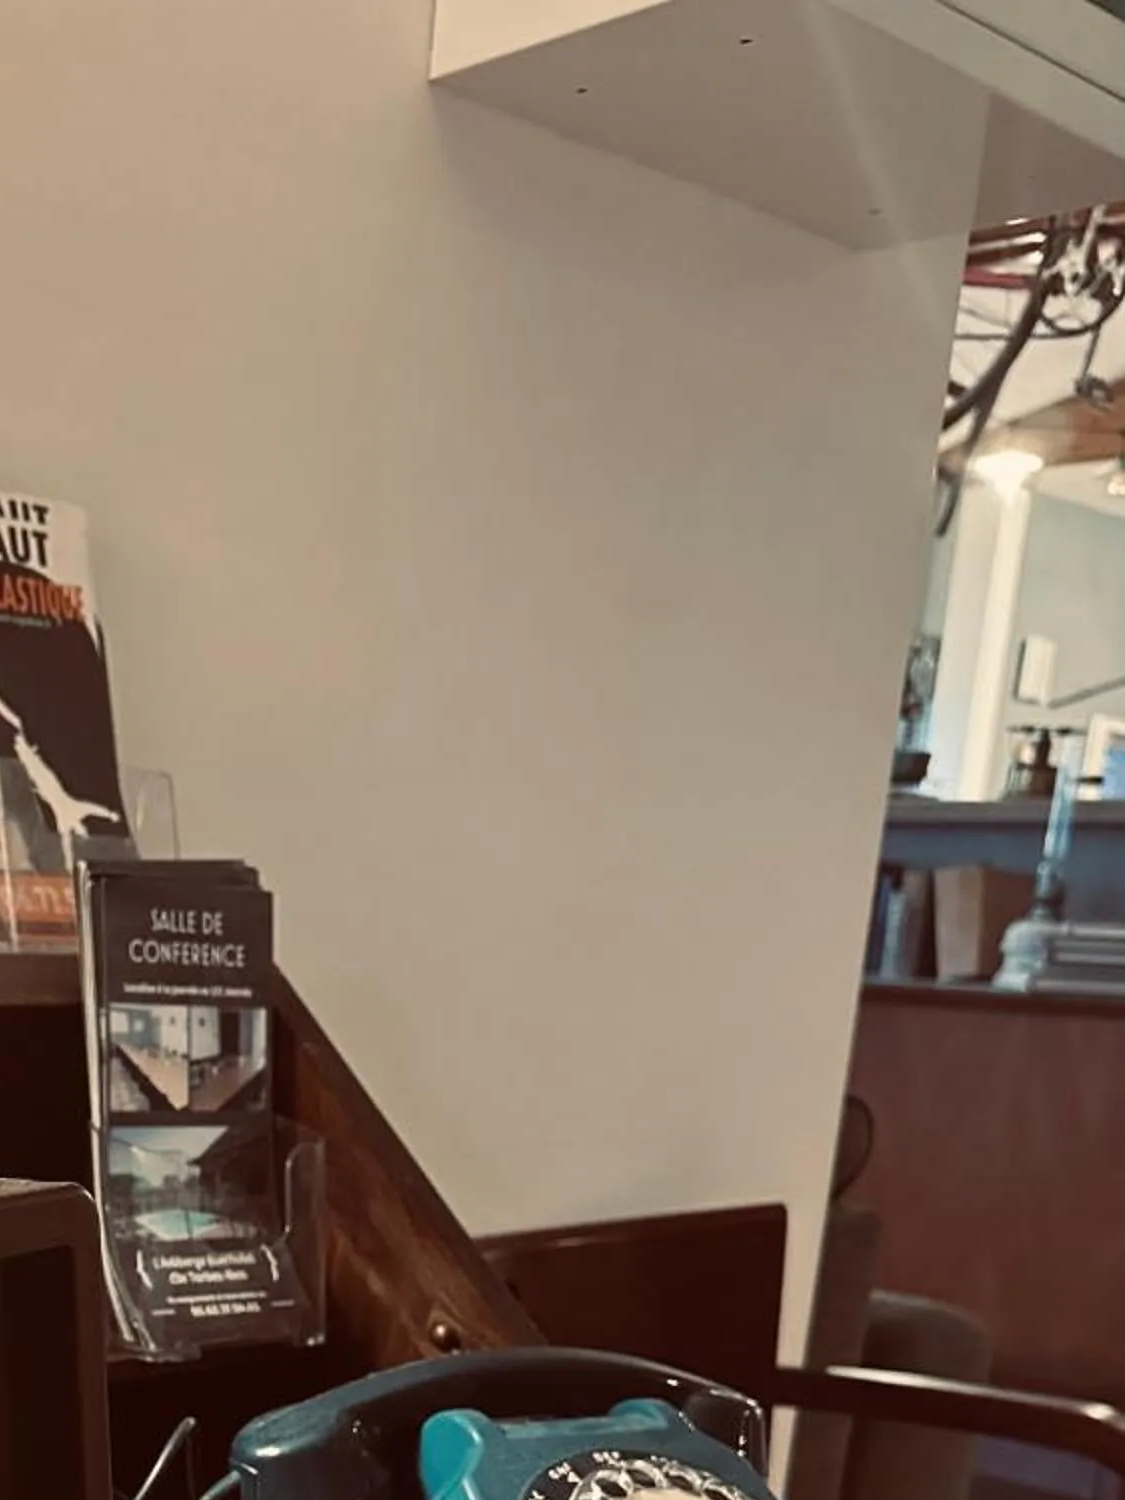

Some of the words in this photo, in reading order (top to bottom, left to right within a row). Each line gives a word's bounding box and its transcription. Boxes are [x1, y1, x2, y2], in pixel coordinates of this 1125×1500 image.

[150, 906, 195, 934] SALLE
[202, 910, 223, 936] DE
[128, 937, 246, 969] CONFERENCE
